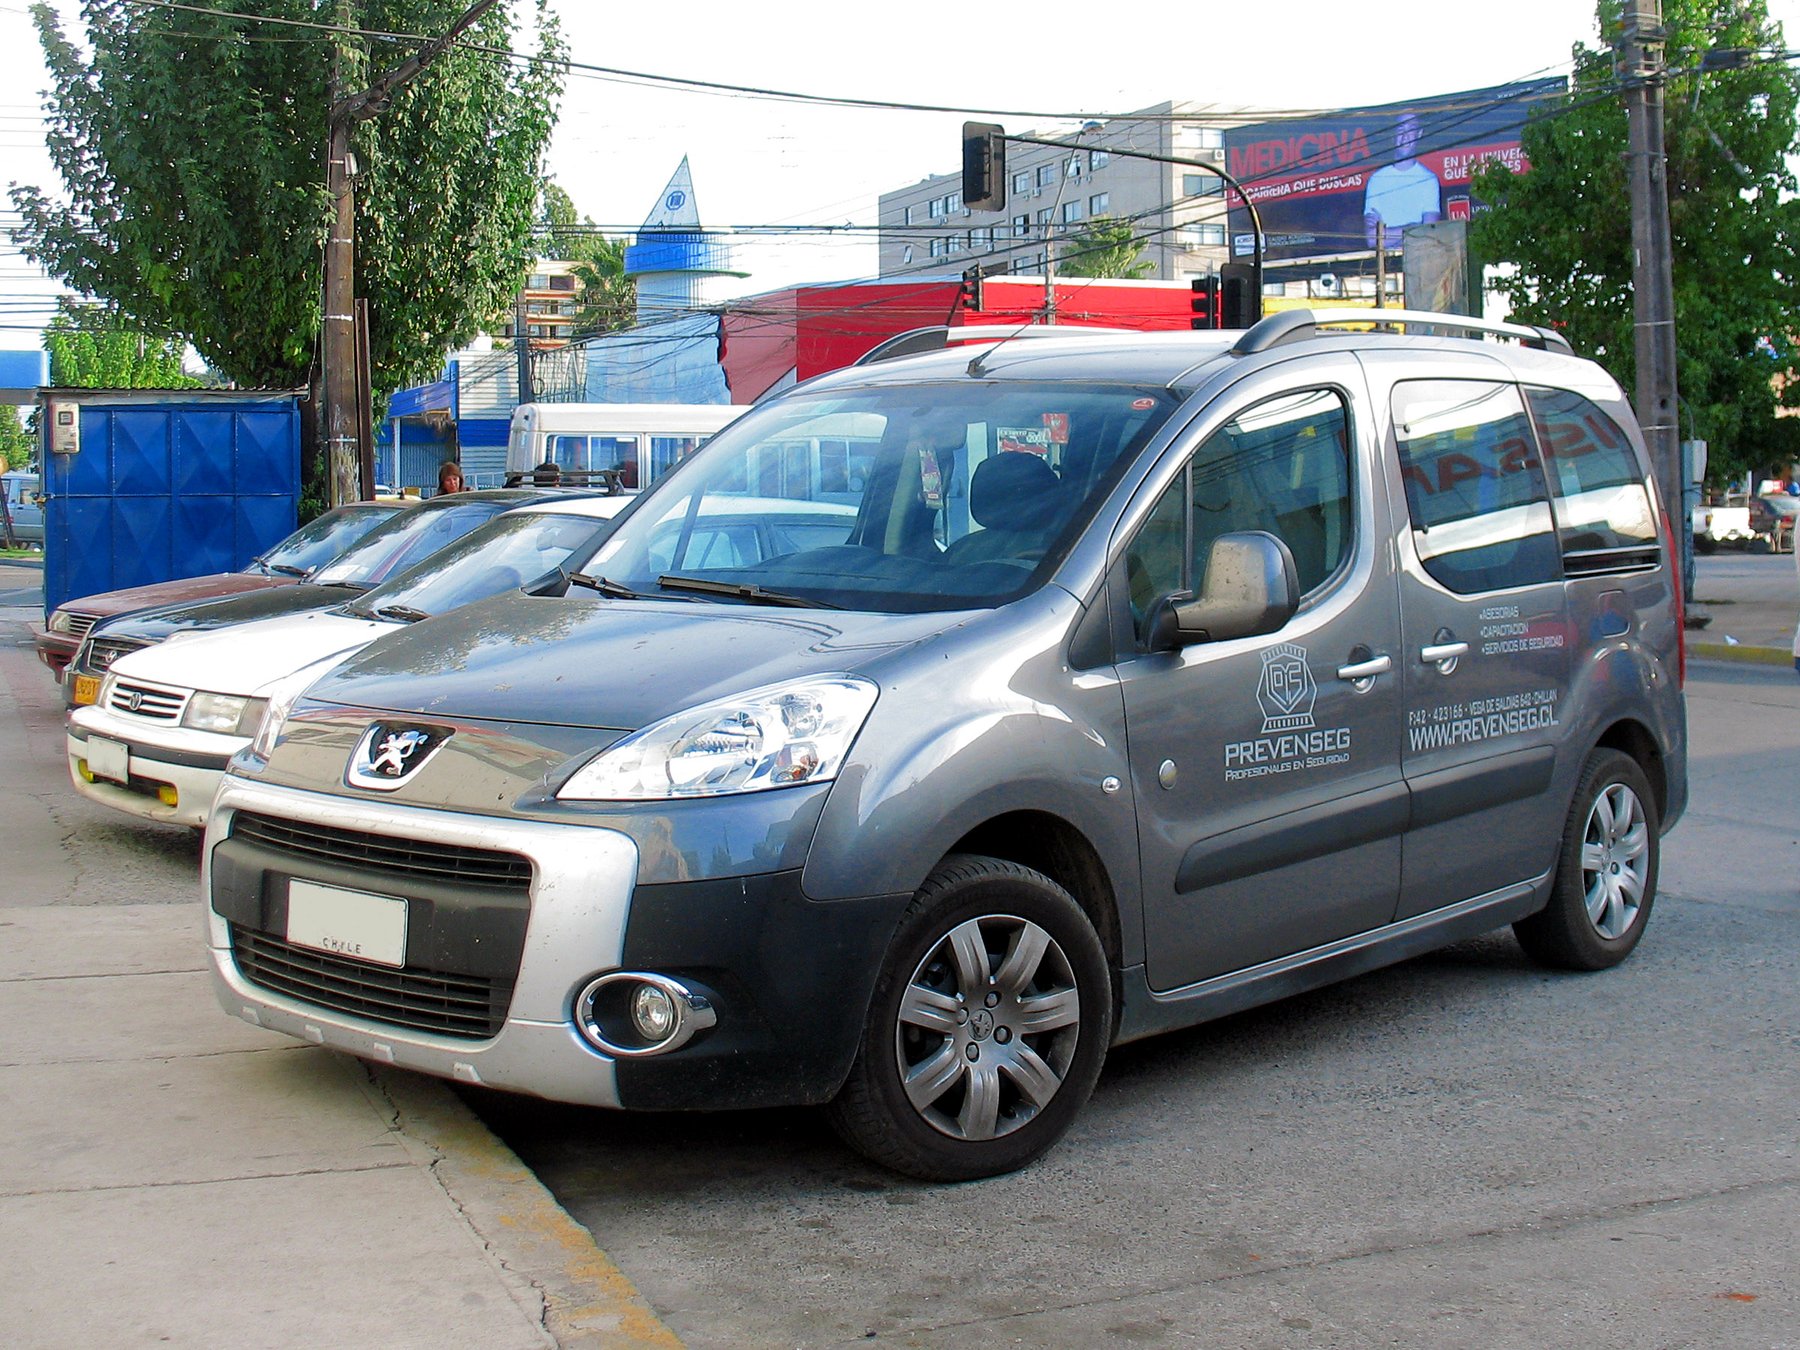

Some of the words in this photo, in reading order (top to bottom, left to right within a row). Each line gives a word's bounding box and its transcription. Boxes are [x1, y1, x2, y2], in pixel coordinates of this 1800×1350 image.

[1230, 128, 1371, 177] MEDICINA
[1444, 156, 1459, 169] EN
[1444, 167, 1468, 180] QUE
[1246, 184, 1292, 199] CARRERA
[1293, 179, 1316, 192] QUE
[1319, 174, 1362, 190] BUSCAS
[1452, 211, 1467, 220] UA
[1482, 606, 1519, 620] ASESORIAS
[1484, 640, 1519, 655] SERVICIOS
[1520, 638, 1529, 651] DE
[1529, 635, 1564, 650] SEGURIDAD
[1486, 698, 1495, 713] DE
[1409, 705, 1559, 752] WWW.PREVENSEG.CL
[1225, 728, 1350, 767] PREVENSEG
[1293, 759, 1305, 770] EN
[1306, 753, 1350, 769] SEGURIDAD
[322, 937, 361, 954] CHILE
